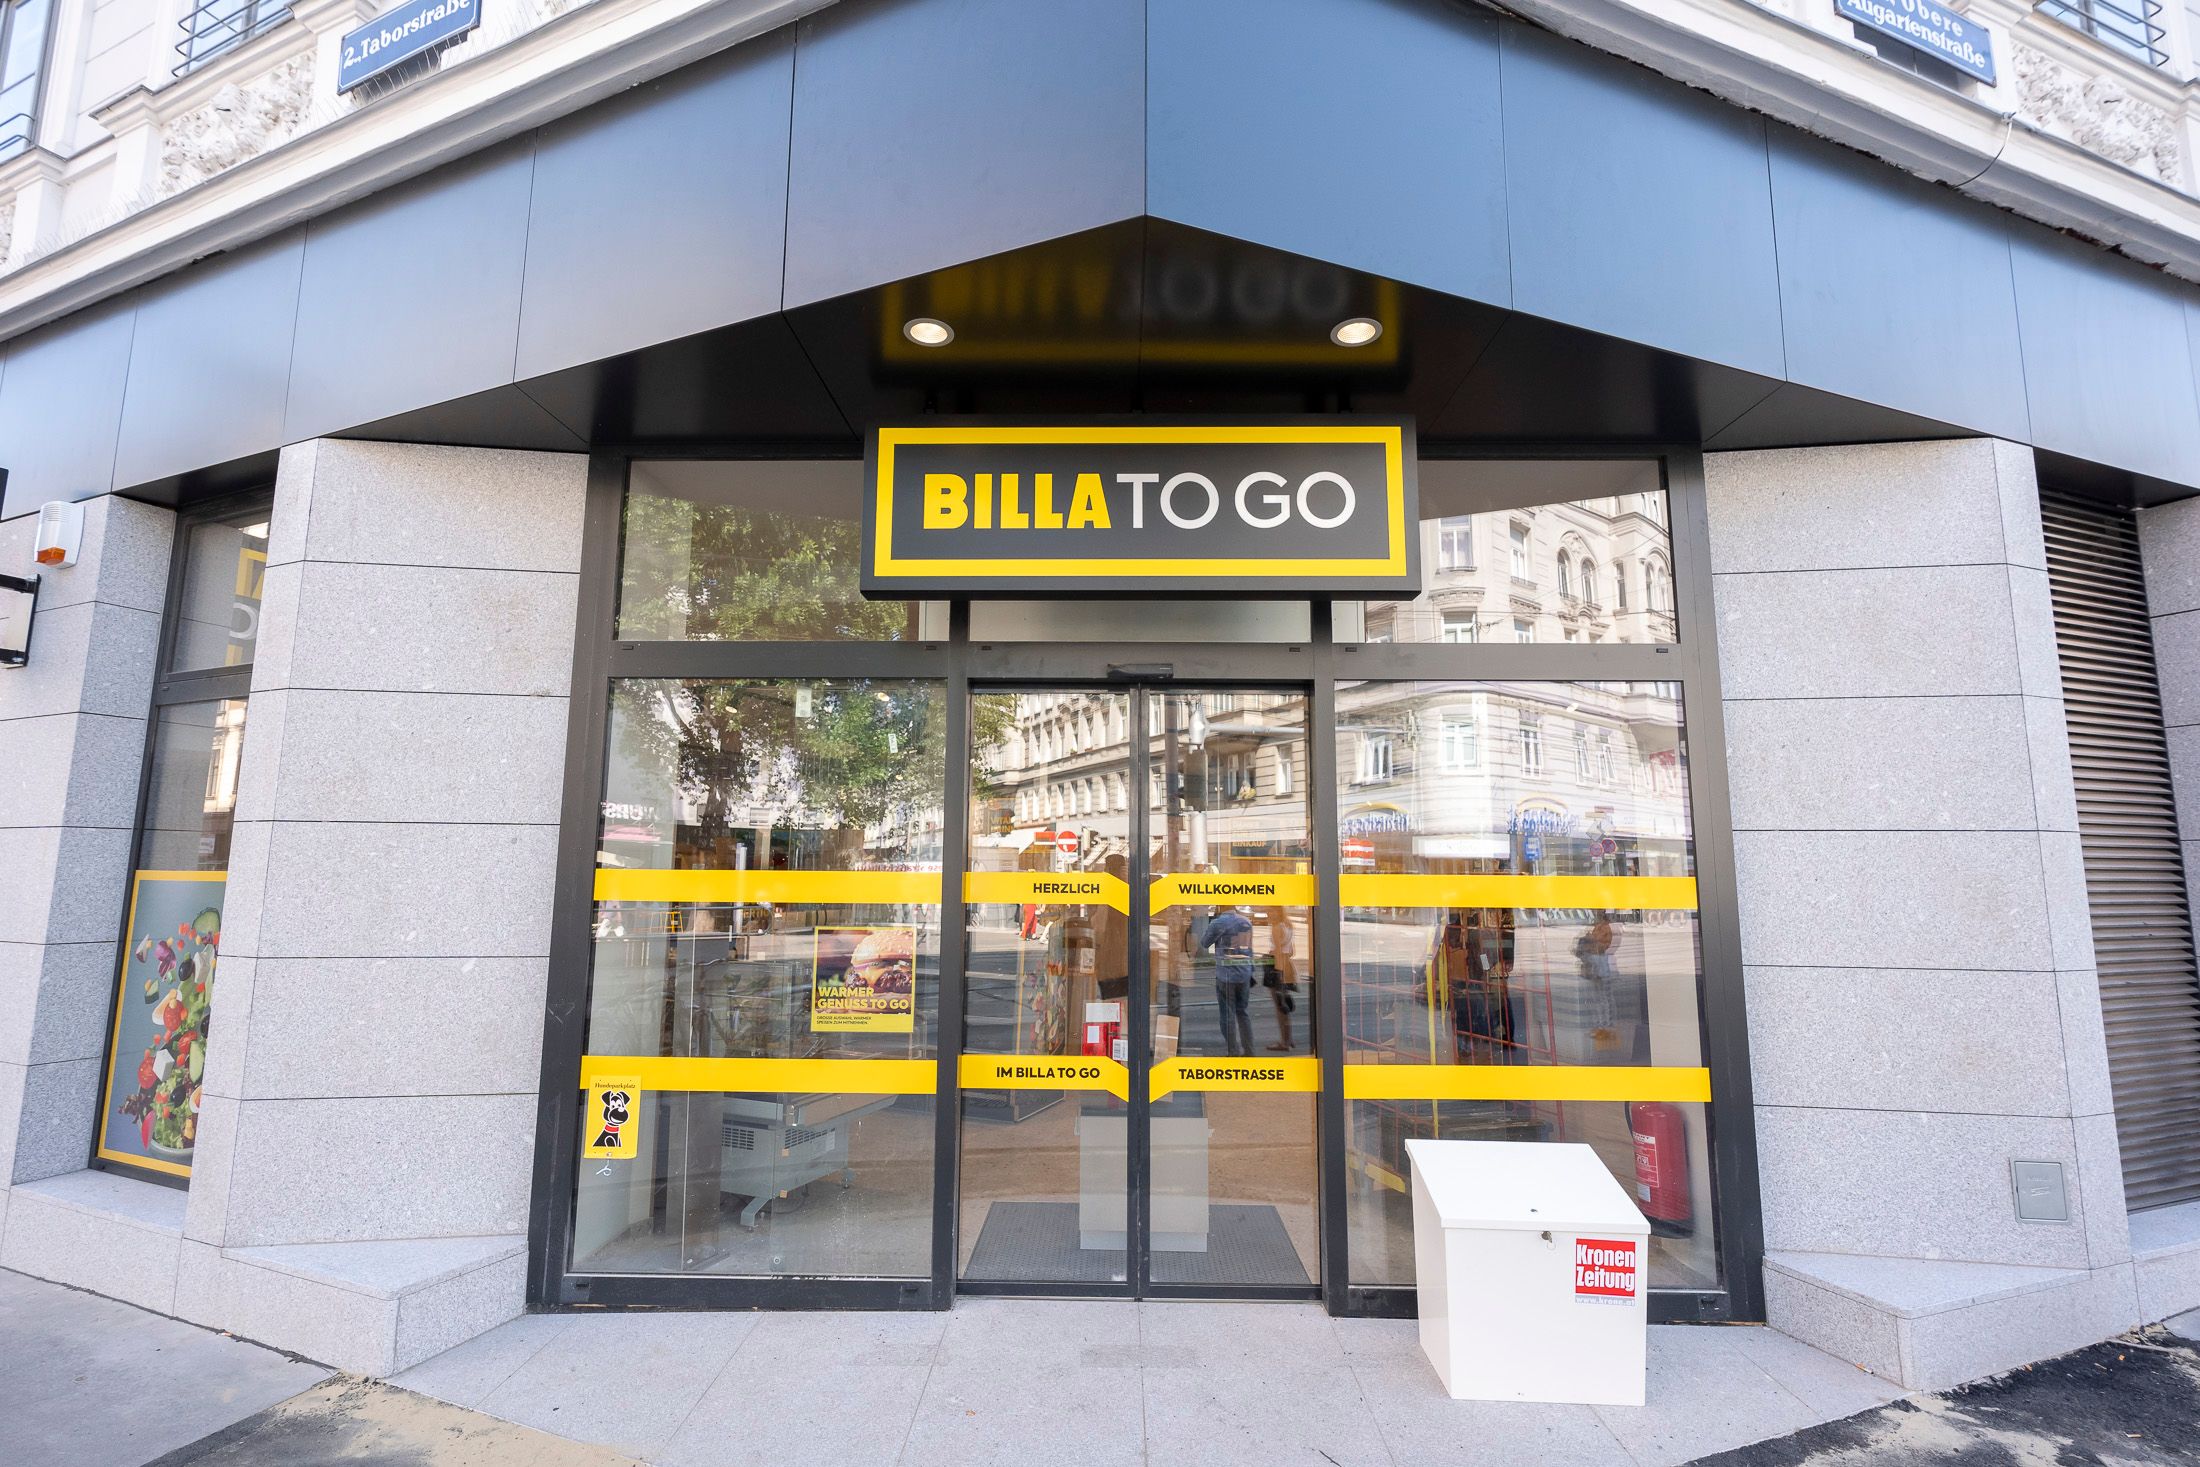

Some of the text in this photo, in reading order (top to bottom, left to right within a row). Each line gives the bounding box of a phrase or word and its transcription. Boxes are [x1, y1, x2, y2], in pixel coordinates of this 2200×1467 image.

[923, 471, 1357, 530] BILLA TO GO
[1033, 883, 1100, 894] HERZLICH
[1178, 883, 1275, 895] WILLKOMMEN
[817, 987, 874, 997] WARMER
[817, 998, 909, 1009] GENUSS TO GO
[996, 1066, 1101, 1079] IM BILLA TO GO
[1178, 1068, 1285, 1081] TABORSTRASSE
[595, 1082, 636, 1090] Hundeparkplatz
[1576, 1244, 1635, 1267] Kronen
[1576, 1266, 1635, 1292] Zeitung
